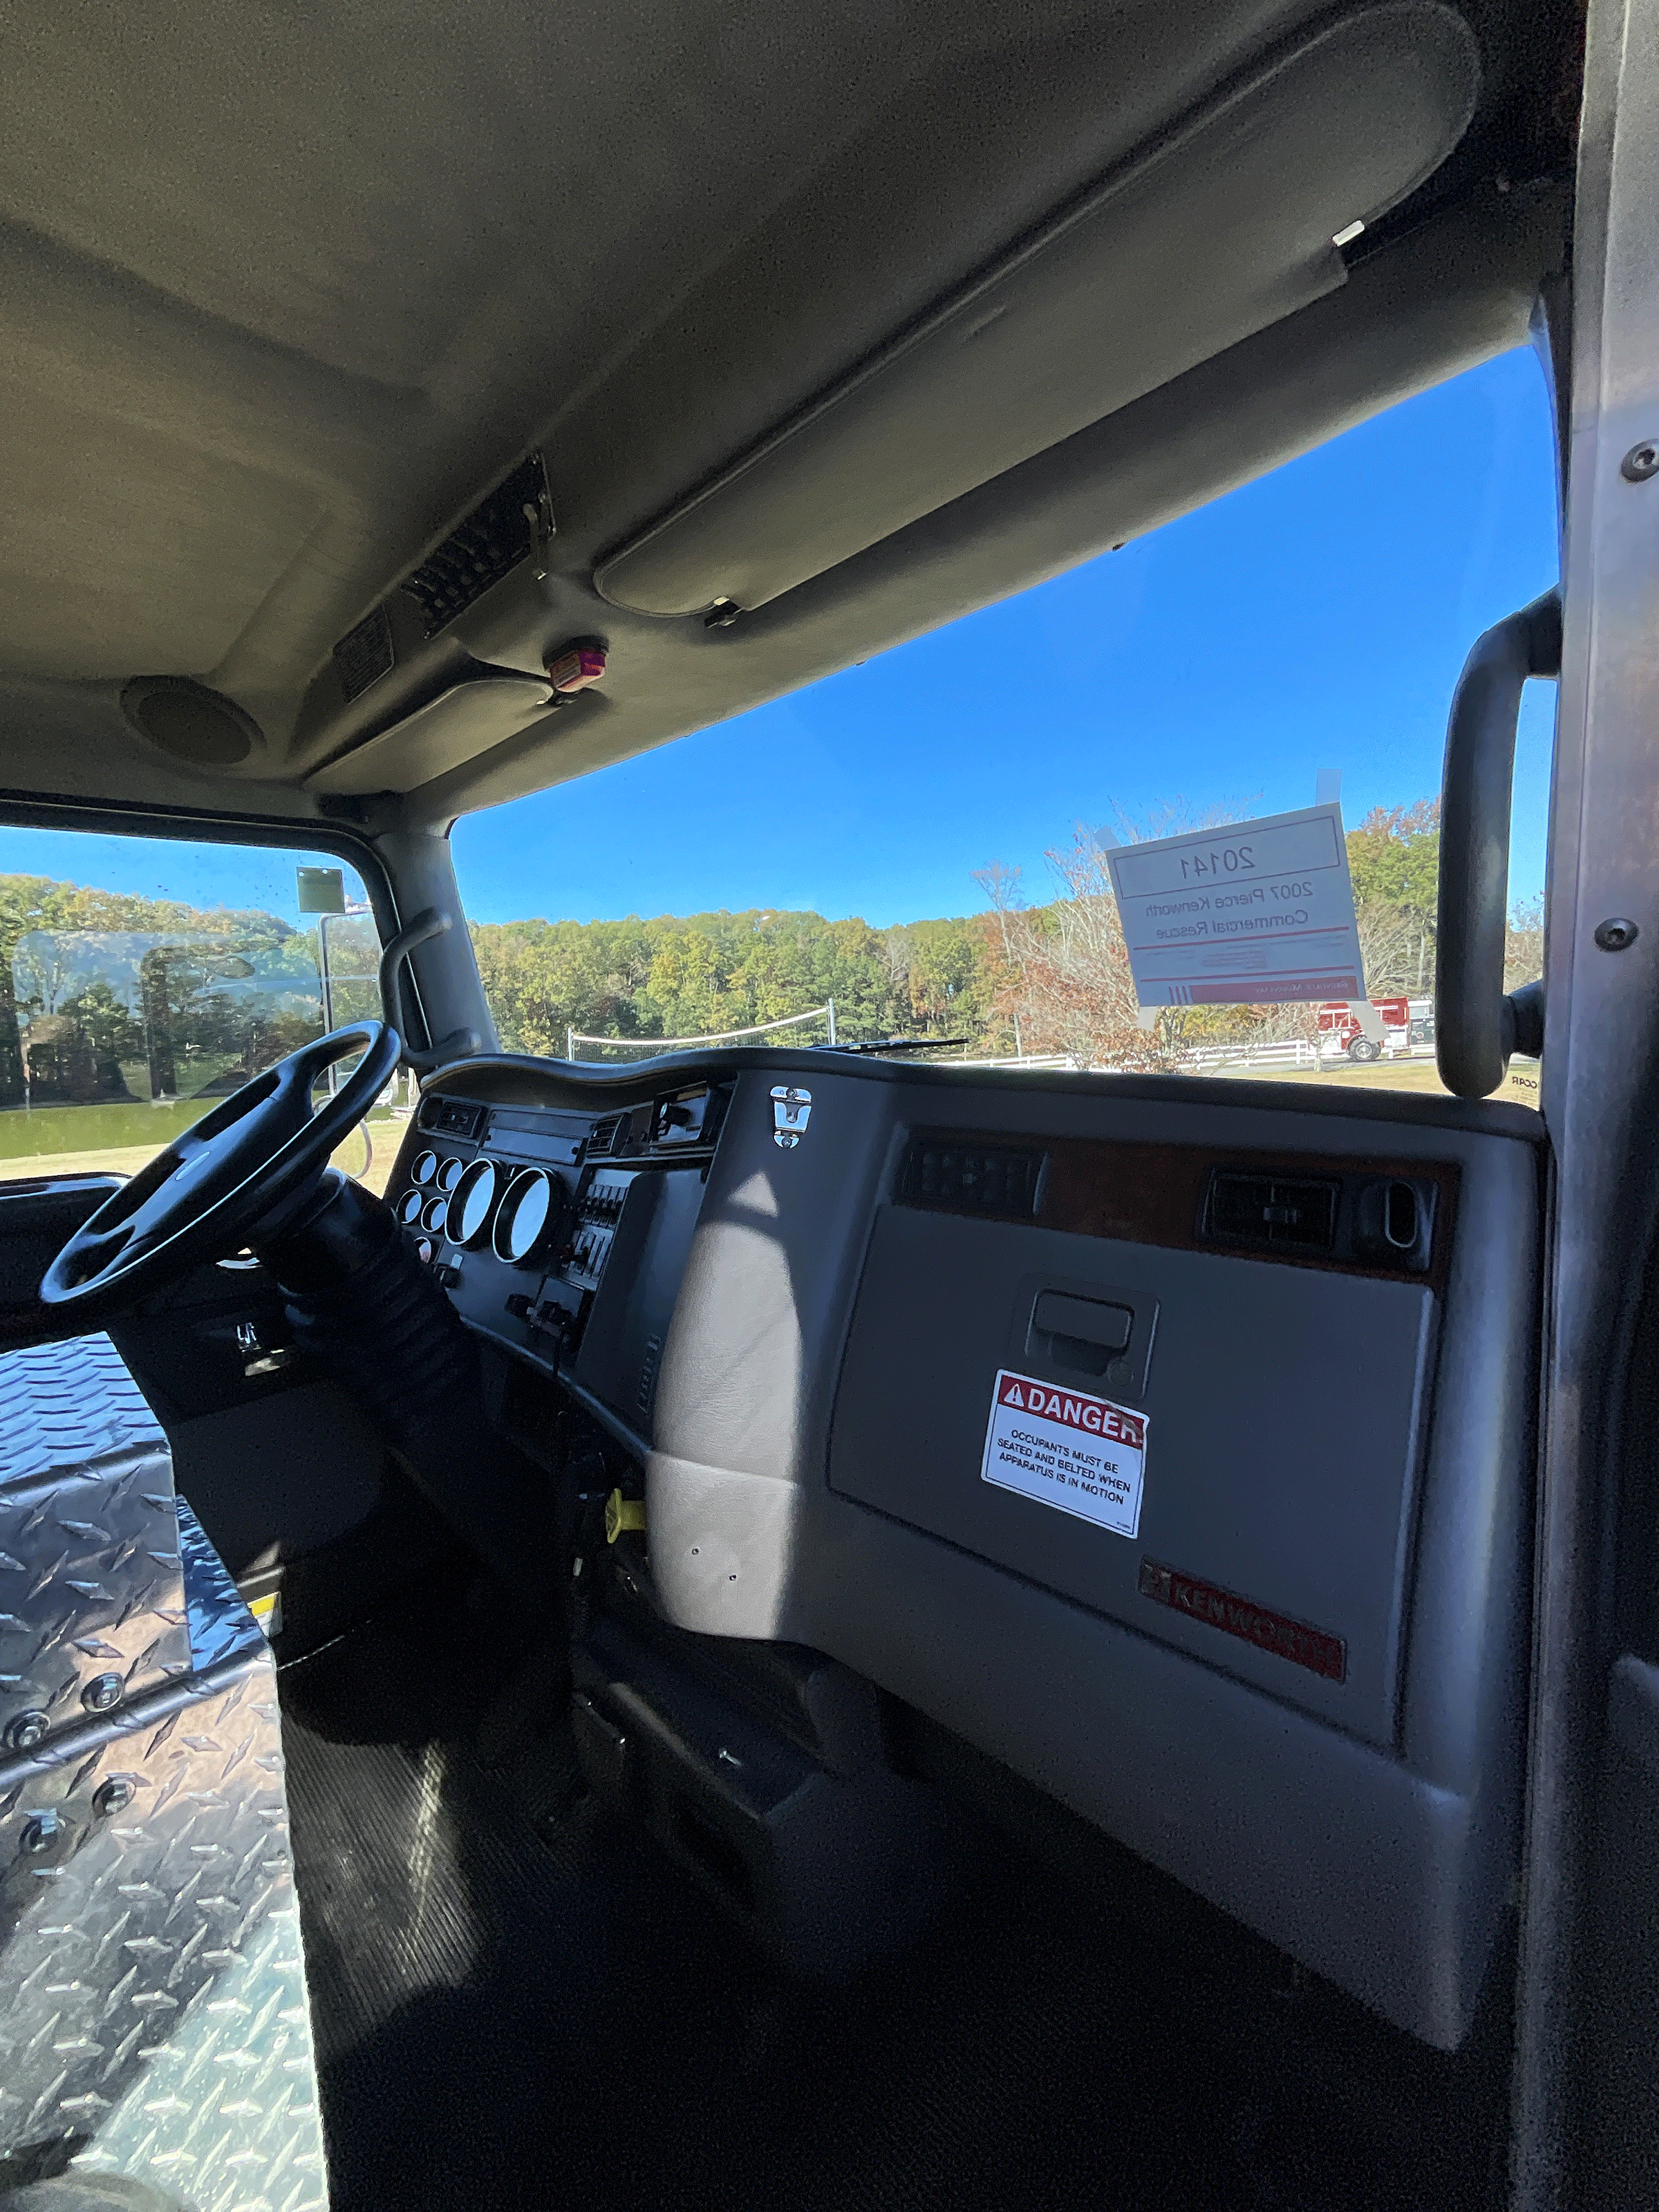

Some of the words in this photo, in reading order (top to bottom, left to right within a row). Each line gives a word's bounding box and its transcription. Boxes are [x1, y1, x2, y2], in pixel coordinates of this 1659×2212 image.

[1028, 1387, 1143, 1444] DANGER
[997, 1438, 1032, 1458] SEATED
[1034, 1450, 1055, 1465] AND
[1058, 1459, 1095, 1481] BELTED
[1098, 1473, 1132, 1493] WHEN
[999, 1452, 1054, 1479] APPARATUS
[1056, 1472, 1066, 1483] IS
[1068, 1477, 1078, 1488] IN
[1080, 1481, 1125, 1505] MOTION
[1011, 1429, 1070, 1457] OCCUPANTS
[1072, 1450, 1102, 1468] MUST
[1104, 1461, 1118, 1474] BE
